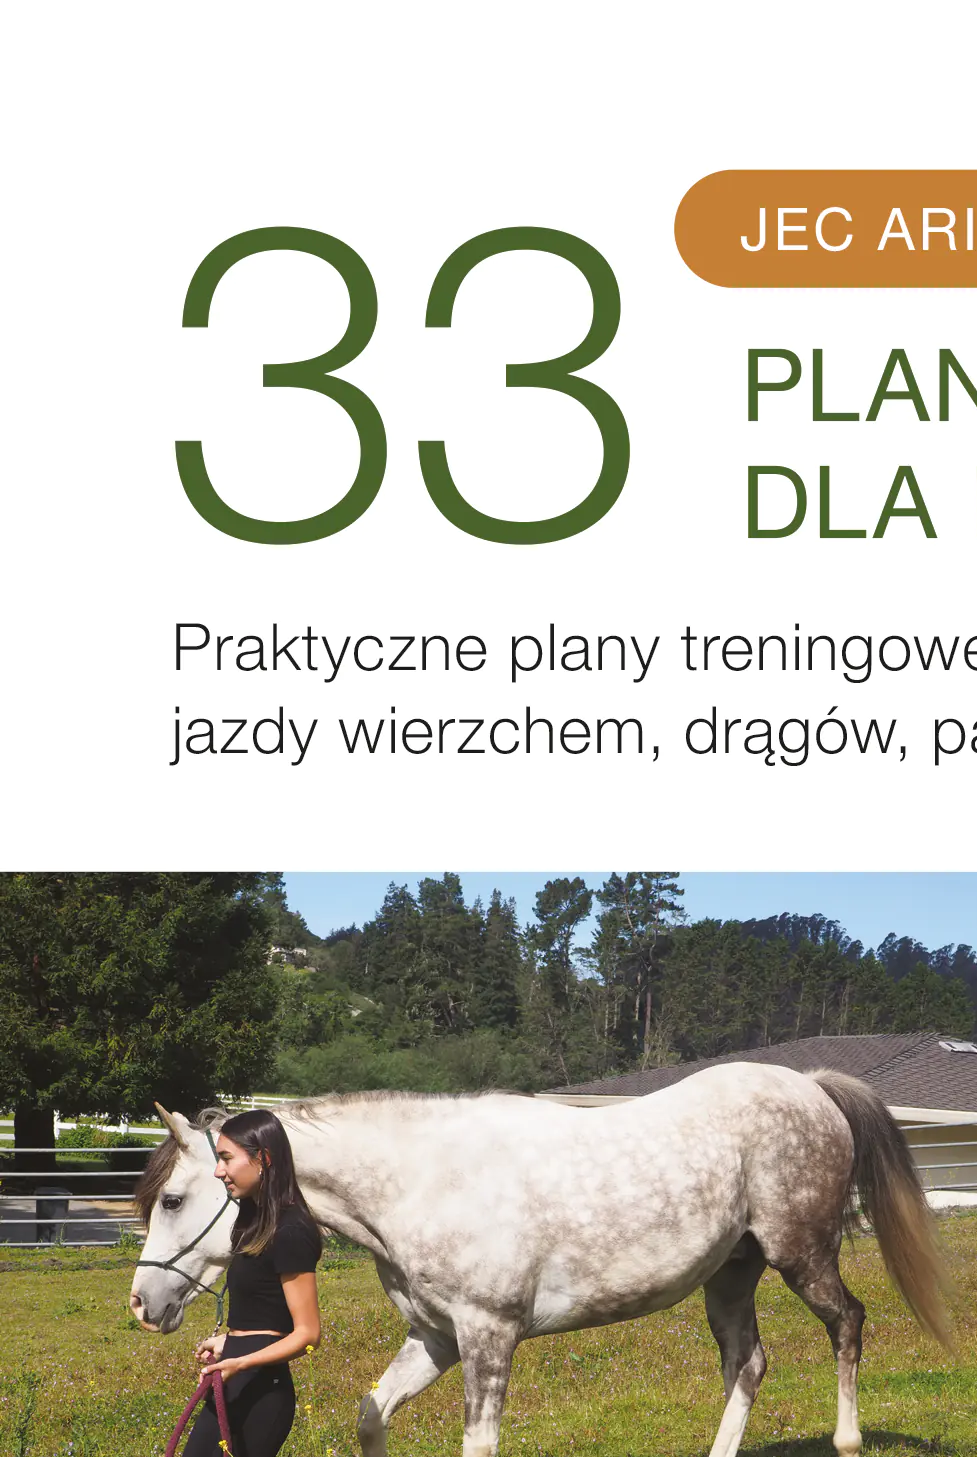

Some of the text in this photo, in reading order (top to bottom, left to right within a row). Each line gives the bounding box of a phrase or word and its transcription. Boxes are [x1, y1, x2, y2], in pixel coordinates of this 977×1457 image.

[741, 207, 853, 252] JEC
[175, 226, 630, 545] 33
[748, 466, 938, 538] DLA
[176, 623, 486, 683] Praktyczne
[512, 623, 660, 683] plany
[169, 706, 318, 766] jazdy
[339, 706, 659, 762] wierzchem,
[686, 706, 906, 766] drągów,
